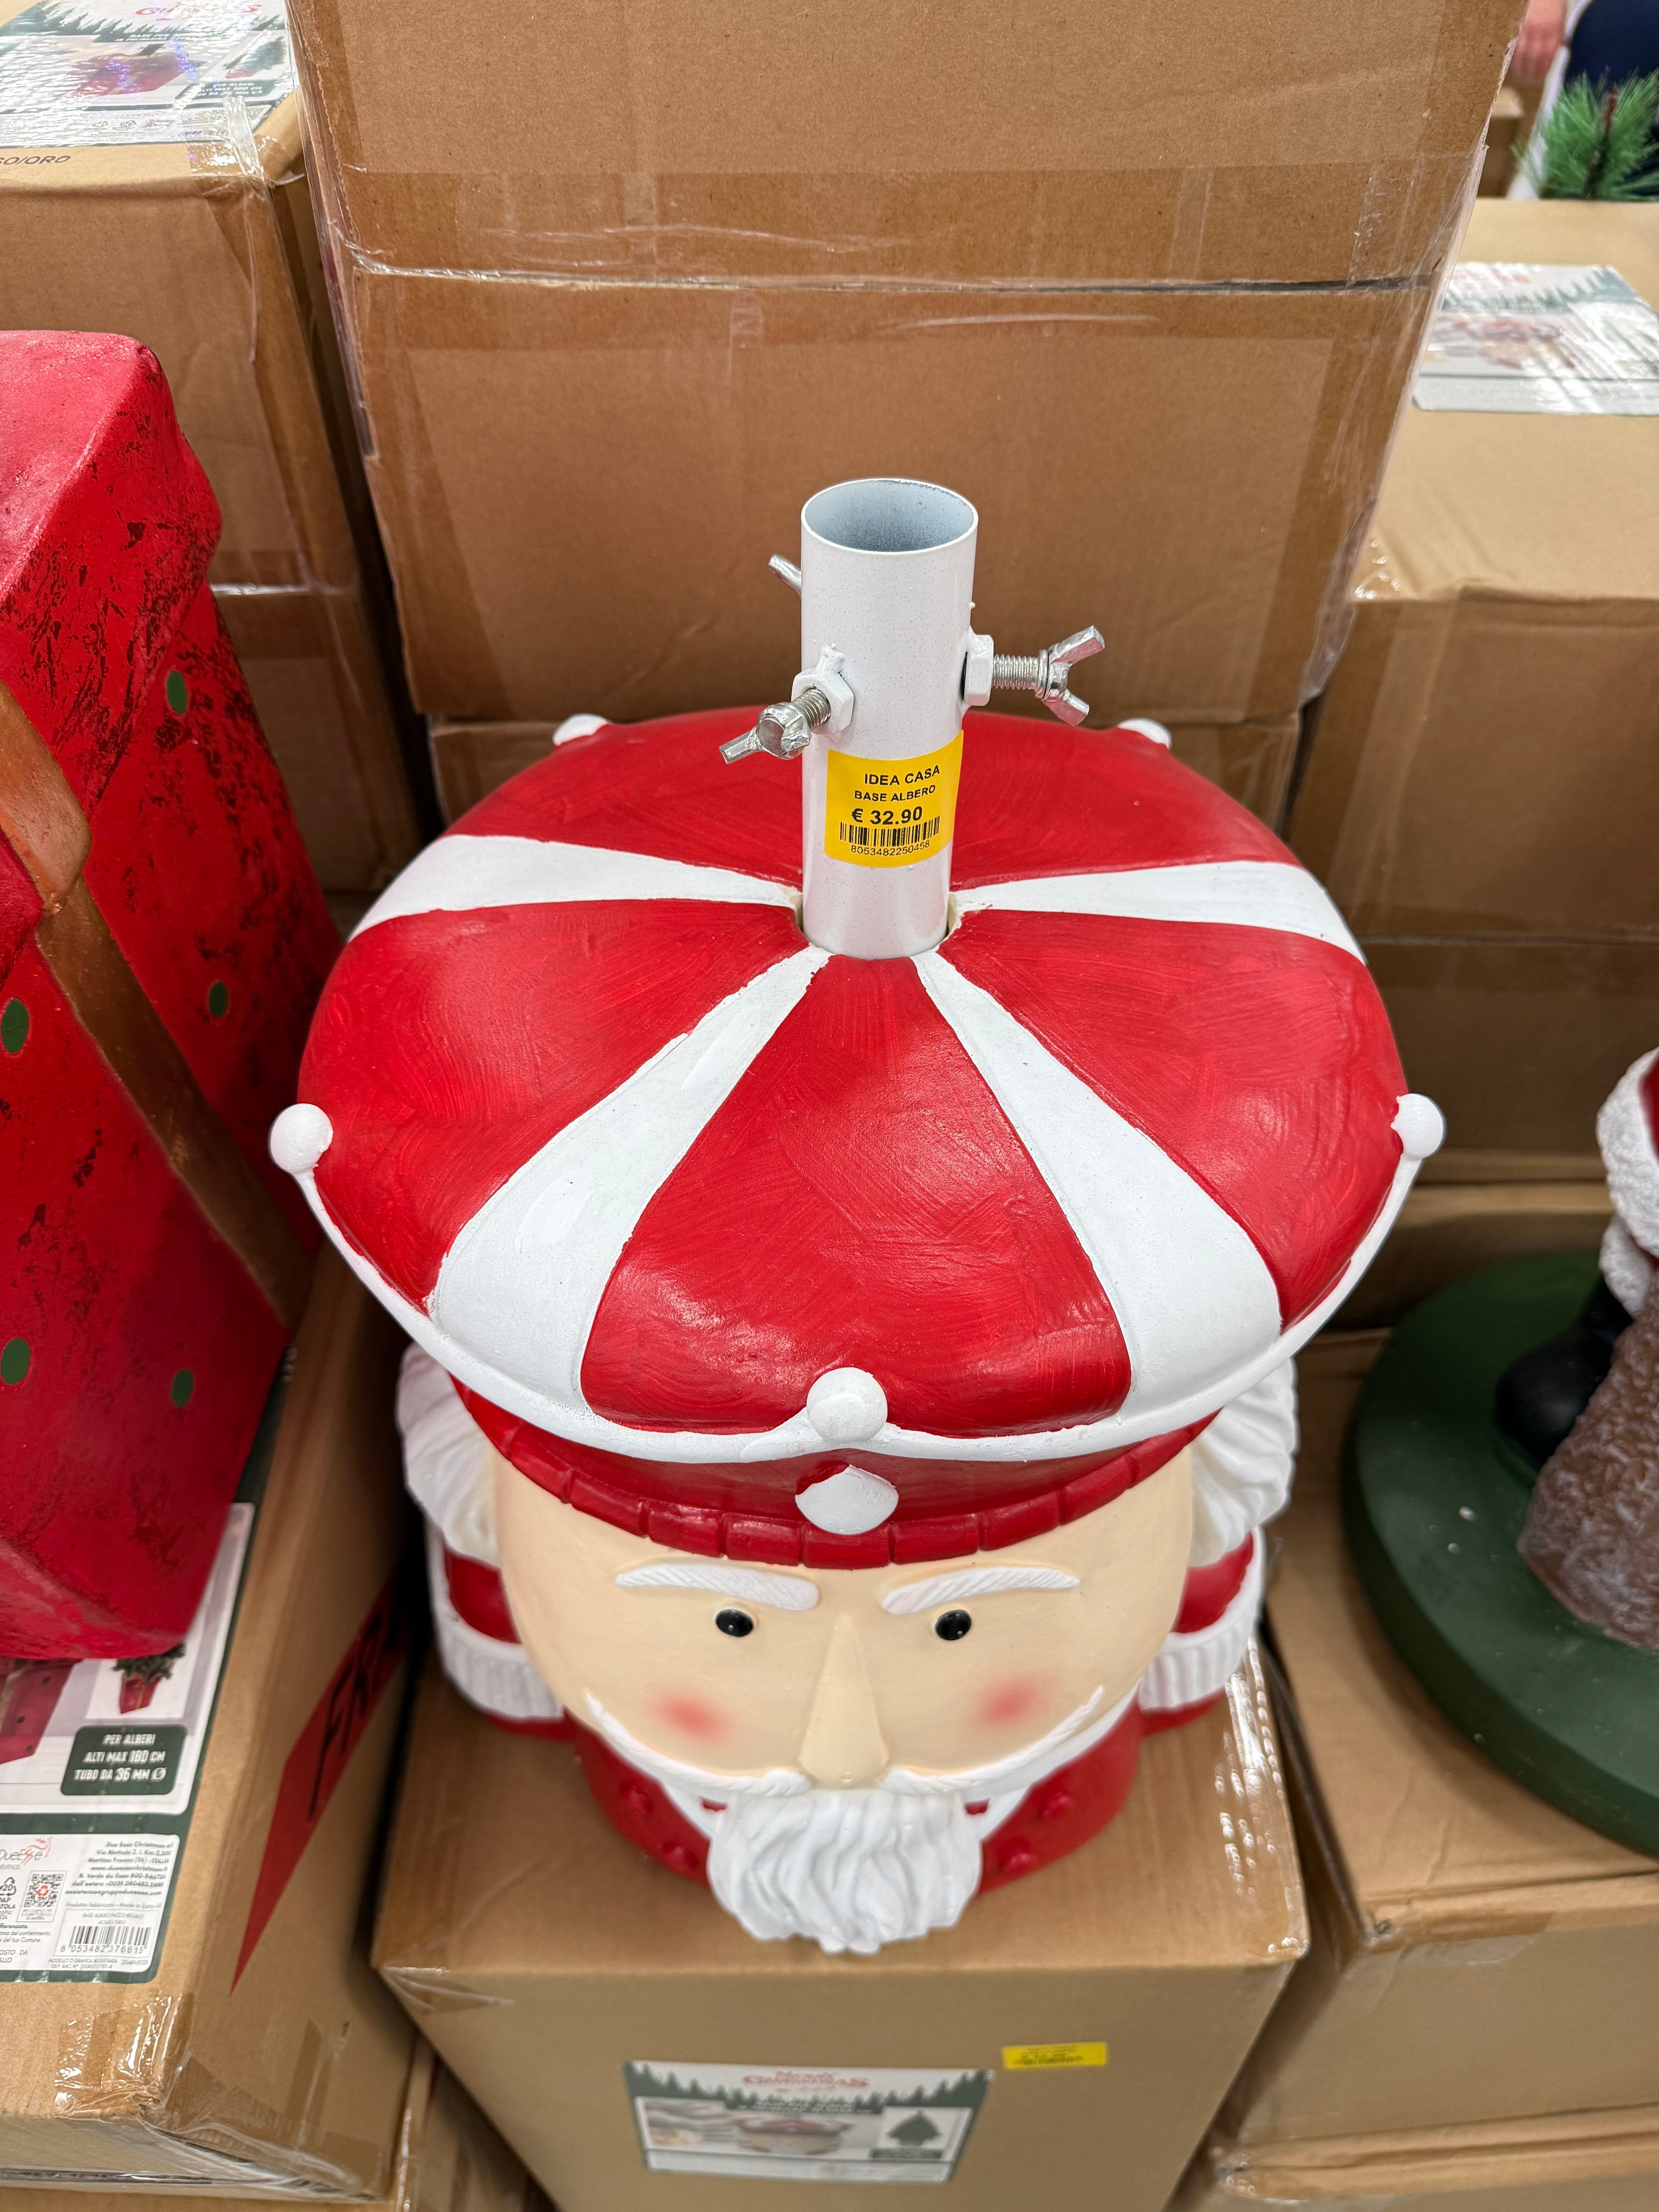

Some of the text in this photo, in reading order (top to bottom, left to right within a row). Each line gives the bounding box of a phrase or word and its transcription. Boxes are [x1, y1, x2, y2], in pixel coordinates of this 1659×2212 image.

[864, 765, 940, 785] IDEA CASA
[855, 785, 936, 801] BASE ALBERO
[851, 806, 922, 825] € 32.90
[851, 840, 930, 856] 8053482250458
[102, 1734, 156, 1745] PER ALBERI
[83, 1750, 166, 1764] ALTI MAX 180 CM
[73, 1769, 99, 1781] TUBO
[99, 1769, 113, 1780] DA
[114, 1767, 131, 1782] 36
[131, 1769, 150, 1781] MM
